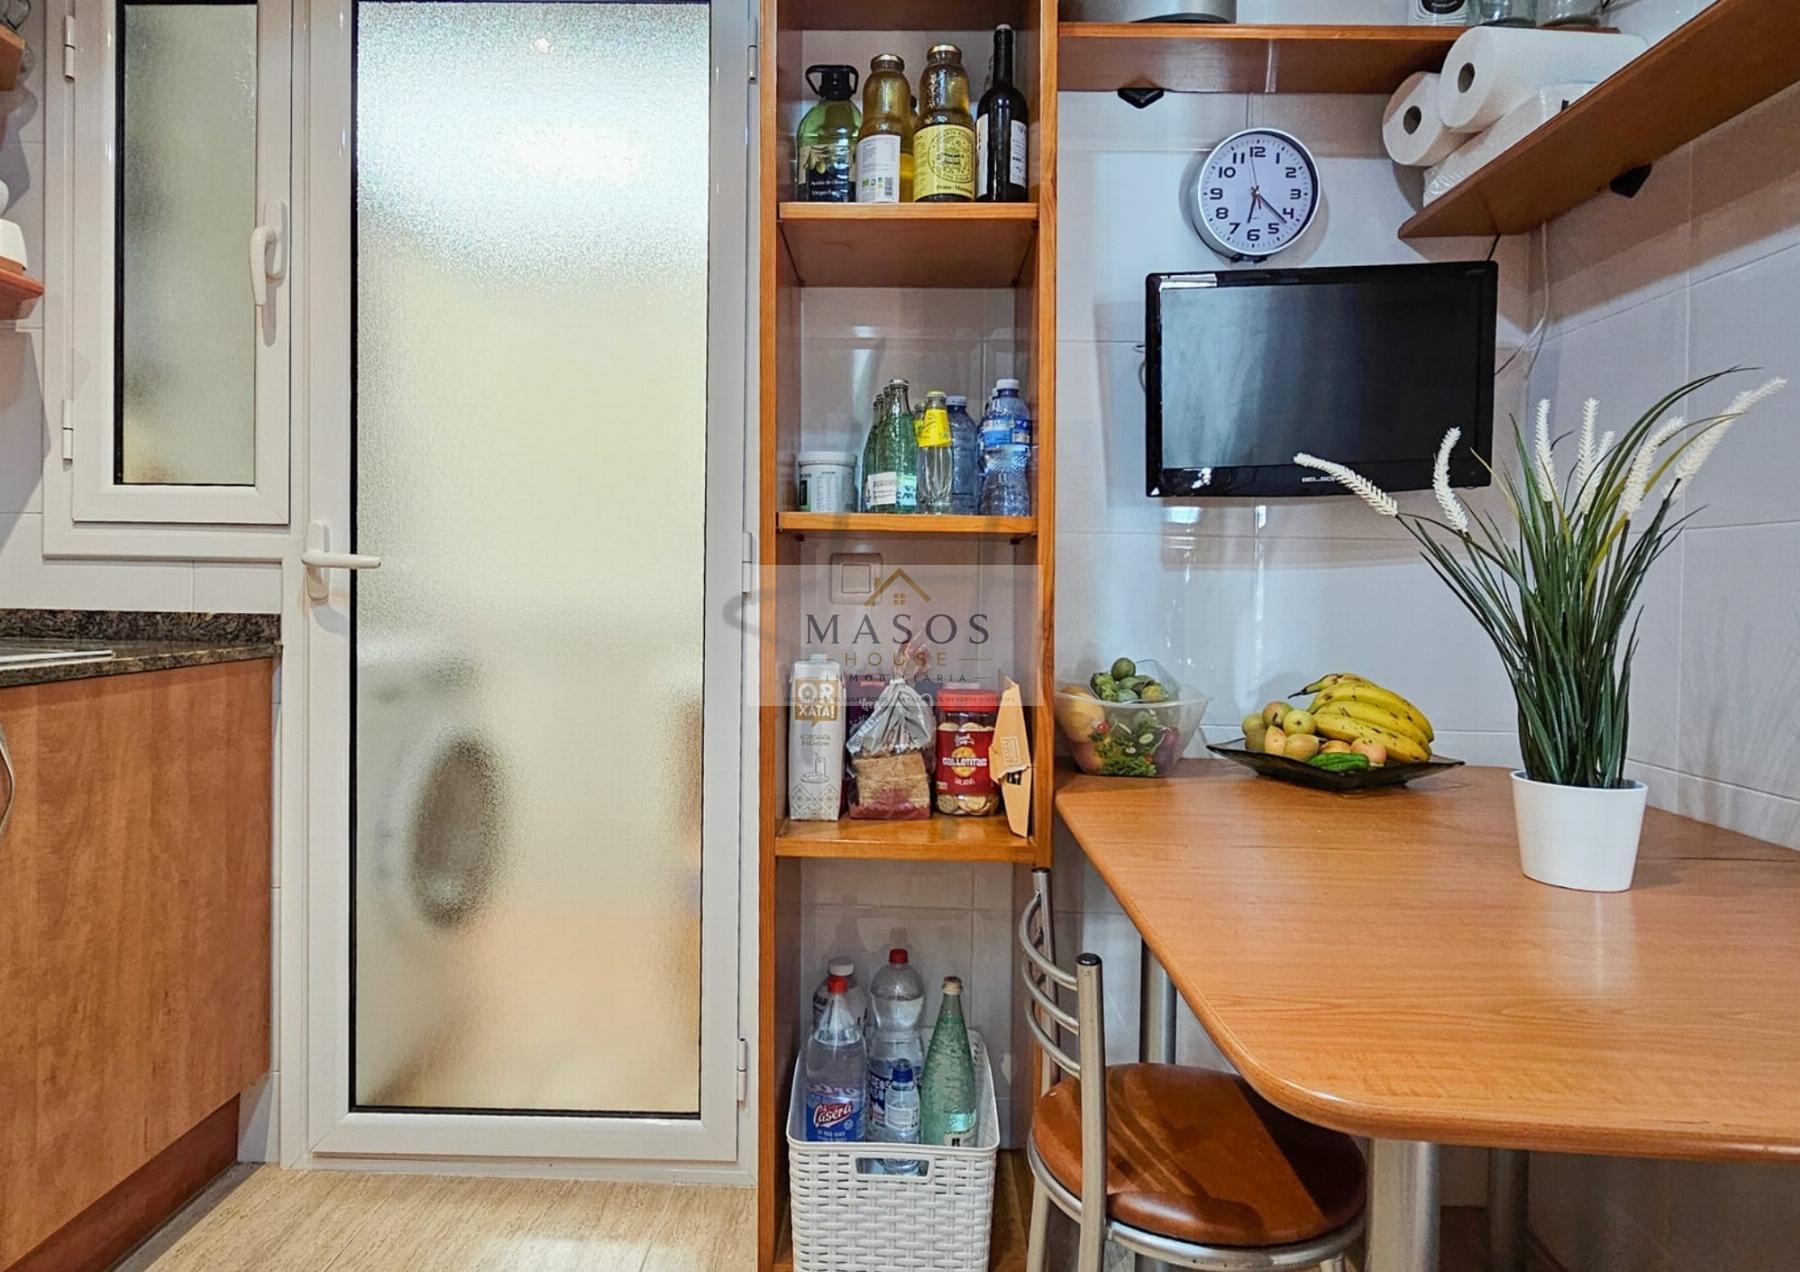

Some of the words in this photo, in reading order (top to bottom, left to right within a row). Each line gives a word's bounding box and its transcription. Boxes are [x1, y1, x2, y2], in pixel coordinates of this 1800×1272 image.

[1232, 152, 1245, 164] 11
[1249, 146, 1266, 158] 12
[1275, 152, 1280, 164] 1
[1218, 166, 1236, 178] 10
[1285, 166, 1297, 178] 2
[1210, 188, 1223, 200] 9
[1290, 188, 1301, 200] 3
[1215, 207, 1229, 219] 8
[1282, 207, 1294, 219] 4
[1229, 222, 1241, 234] 7
[1268, 222, 1280, 234] 5
[1247, 229, 1261, 241] 6
[798, 682, 833, 704] OR
[799, 704, 835, 719] XATA!
